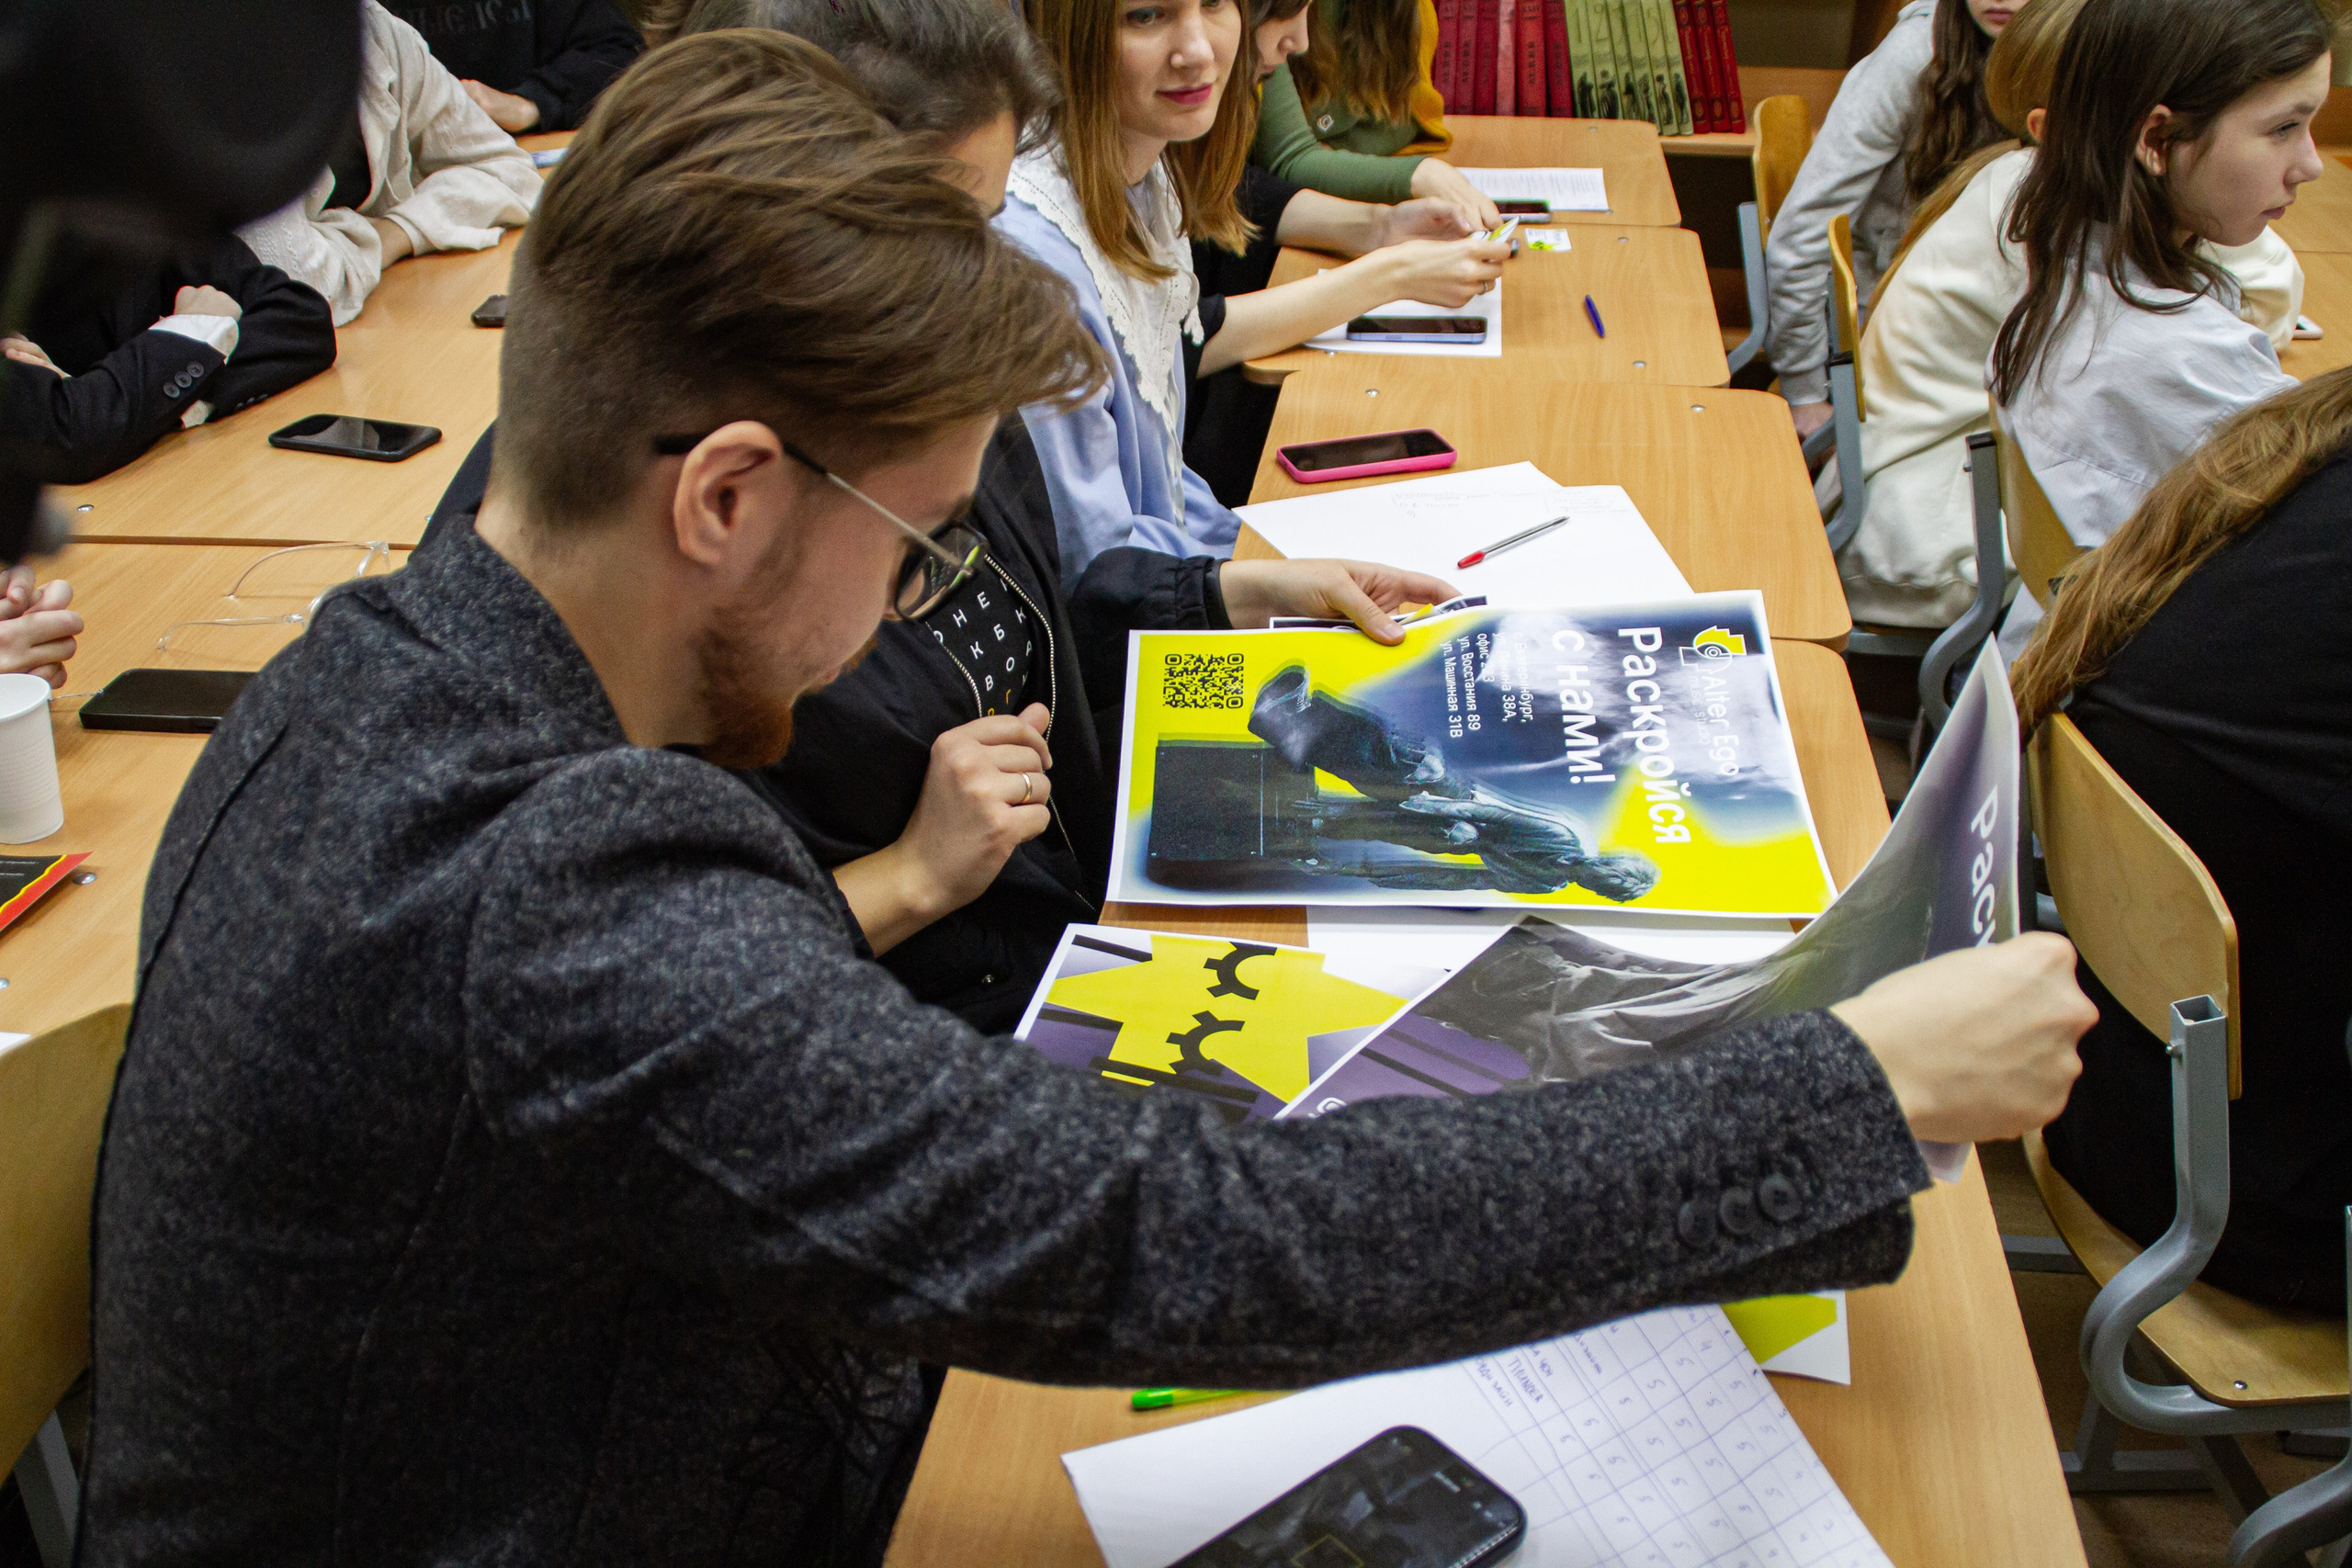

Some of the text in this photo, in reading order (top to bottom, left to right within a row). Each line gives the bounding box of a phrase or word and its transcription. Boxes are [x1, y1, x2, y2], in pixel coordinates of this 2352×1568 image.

[1440, 639, 1454, 656] ул.
[1476, 633, 1490, 659] офис
[1444, 657, 1459, 711] Машинная
[1457, 636, 1481, 731] ул. Восстания 89
[1556, 664, 1616, 784] нами!
[1618, 626, 1692, 843] Раскройся
[1702, 675, 1740, 776] Alter Ego
[1509, 1355, 1544, 1404] THUNDER
